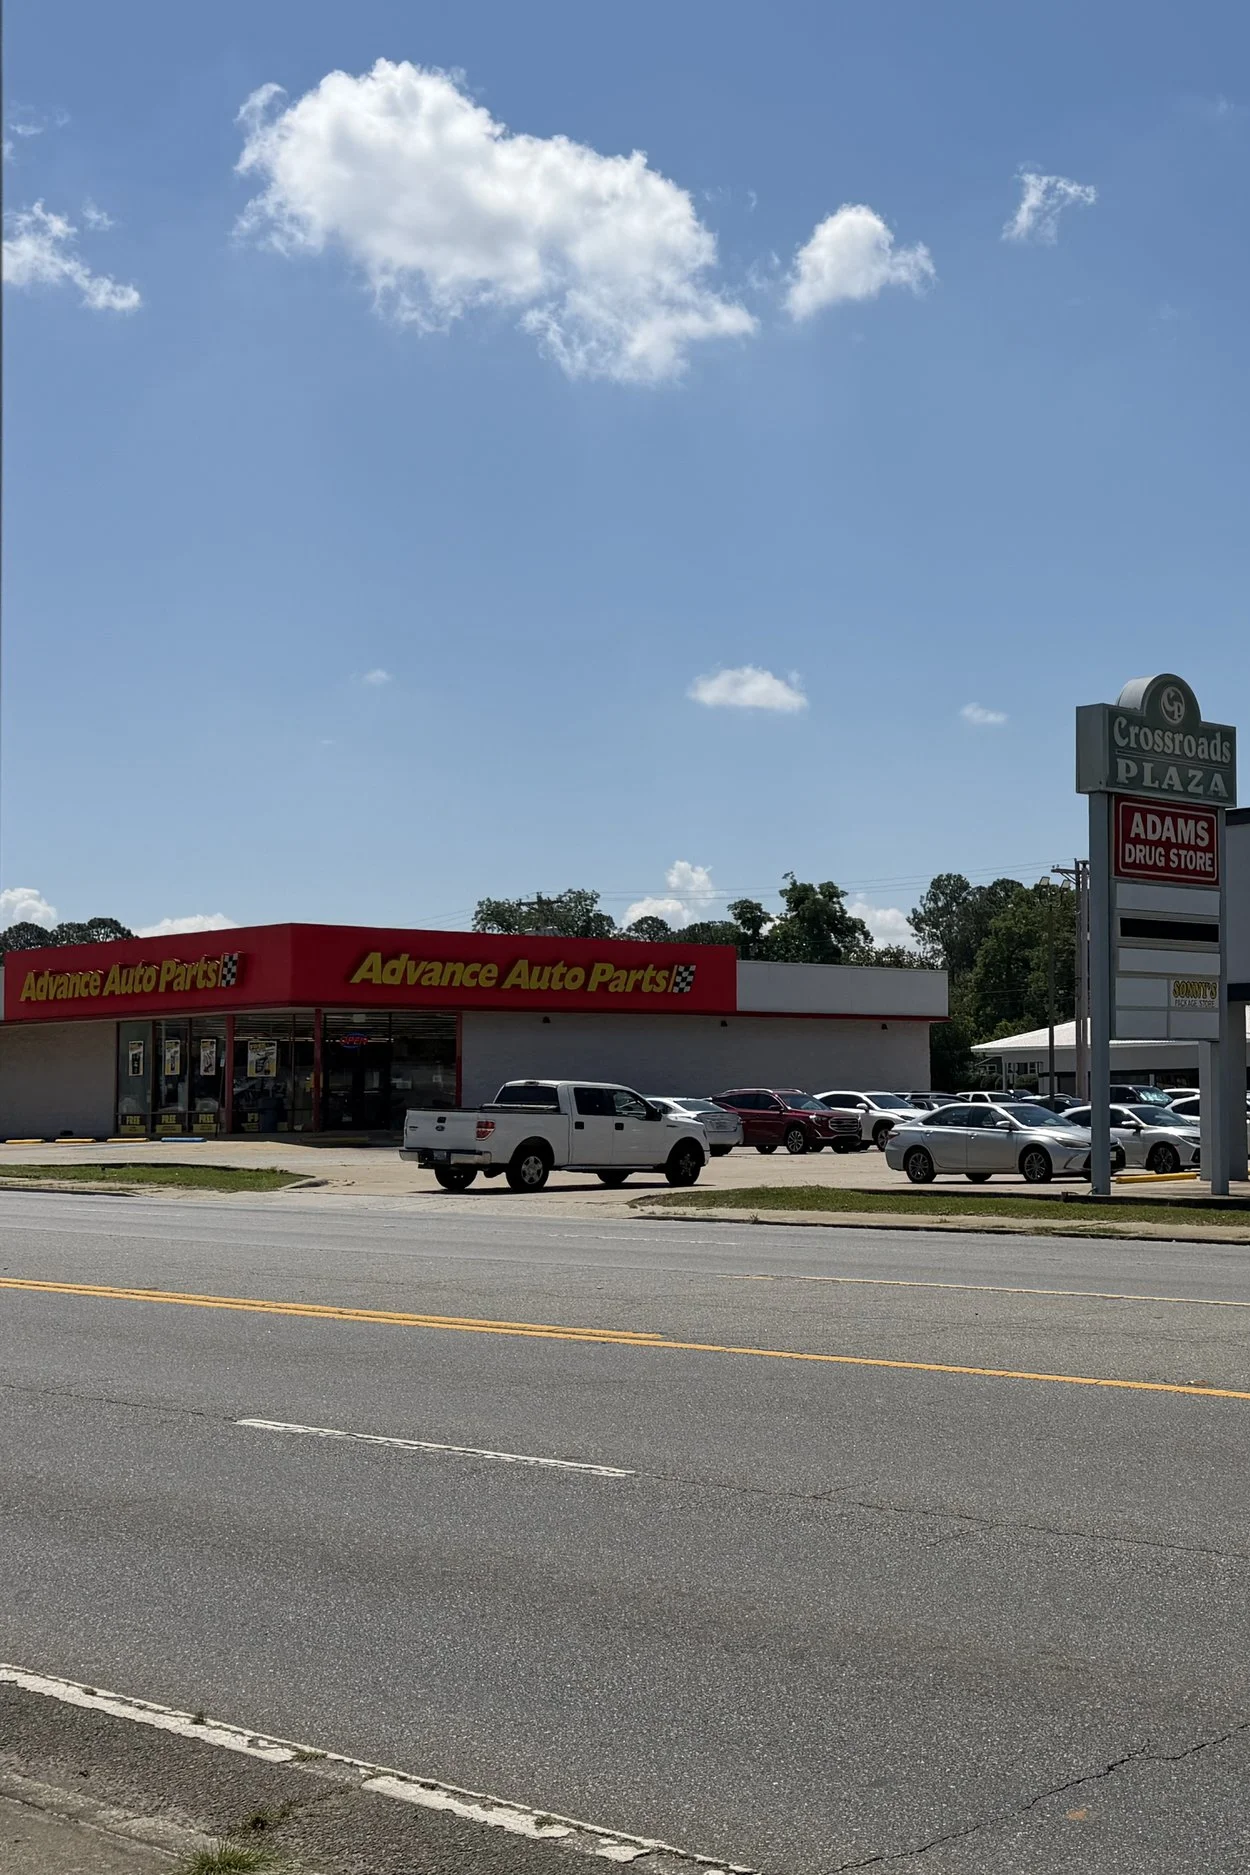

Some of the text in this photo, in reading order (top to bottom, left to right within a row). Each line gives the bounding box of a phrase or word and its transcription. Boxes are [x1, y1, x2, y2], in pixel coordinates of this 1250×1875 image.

[1113, 716, 1232, 763] Crossroads
[1116, 758, 1229, 798] PLAZA
[1130, 812, 1209, 847] ADAMS
[1124, 844, 1214, 872] DRUG STORE
[20, 957, 217, 1002] Advance Auto Parts
[349, 951, 669, 993] Advance Auto Parts
[1174, 980, 1217, 999] SONNY'S
[1199, 1000, 1215, 1008] STORE
[340, 1035, 368, 1046] OPEN
[126, 1116, 141, 1125] FREE
[161, 1114, 176, 1124] FREE
[199, 1114, 215, 1123] FREE
